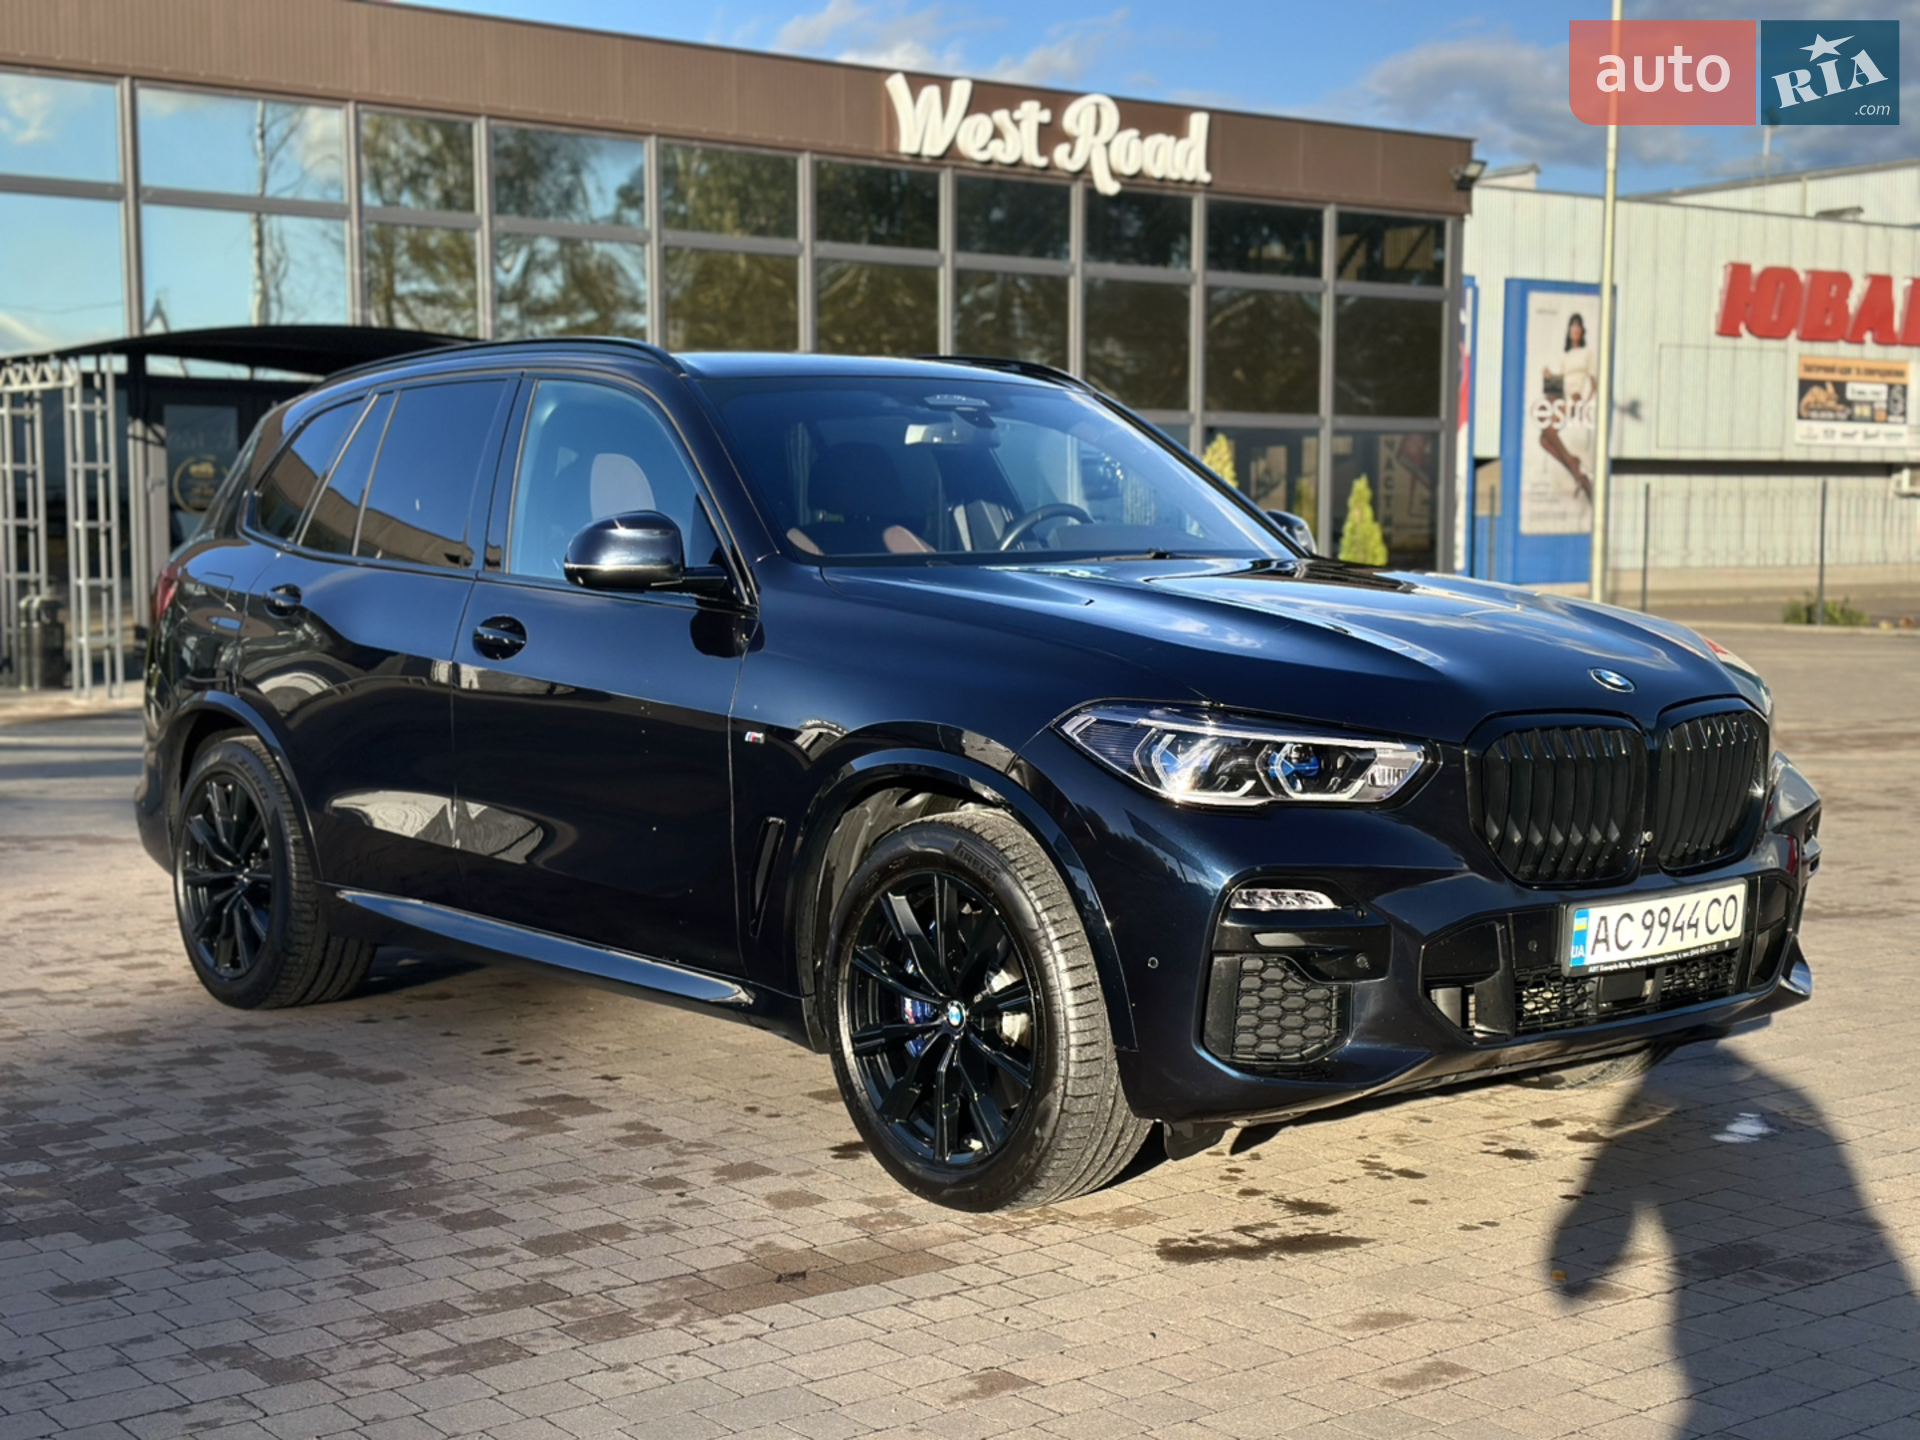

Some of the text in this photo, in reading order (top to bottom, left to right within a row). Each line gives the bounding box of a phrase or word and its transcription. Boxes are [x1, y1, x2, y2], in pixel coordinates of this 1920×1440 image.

[885, 72, 1212, 196] West Road
[1571, 945, 1586, 958] UA
